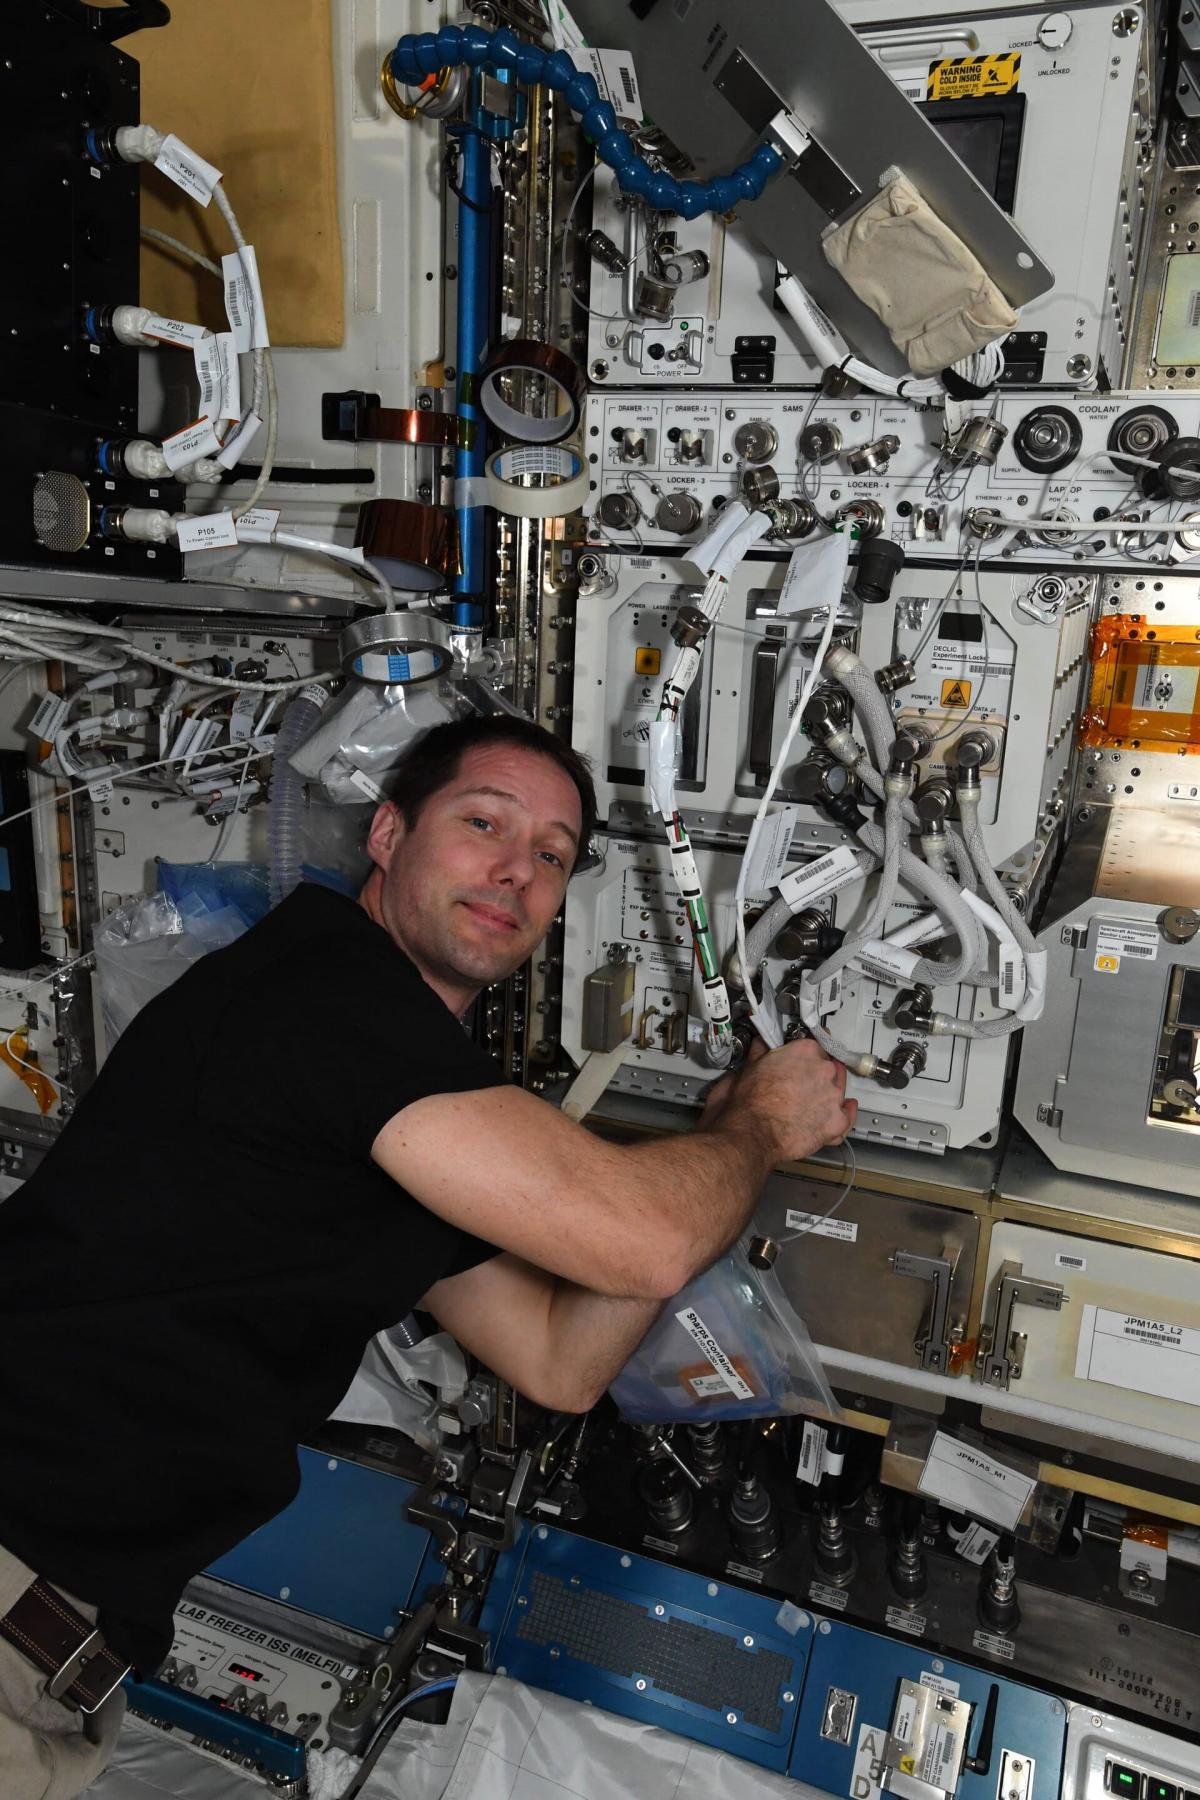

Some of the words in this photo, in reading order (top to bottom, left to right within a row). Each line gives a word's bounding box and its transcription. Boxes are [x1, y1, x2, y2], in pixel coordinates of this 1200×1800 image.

[940, 65, 982, 76] WARNING
[1038, 68, 1070, 76] UNLOCKED
[939, 76, 957, 85] COLD
[958, 74, 982, 82] INSIDE
[180, 162, 196, 179] P201
[167, 322, 184, 332] P202
[182, 440, 199, 451] P103
[198, 528, 216, 536] P105
[933, 652, 966, 660] Experiment
[1126, 929, 1156, 938] Atmosphere
[1124, 1317, 1183, 1336] JPM1A5_L2
[687, 1312, 709, 1339] Sharps
[706, 1340, 736, 1378] Container
[956, 1451, 1006, 1481] JPM1A5_M1
[178, 1604, 206, 1624] LAB
[206, 1614, 268, 1644] FREEZER
[267, 1637, 290, 1652] ISS
[290, 1647, 342, 1674] (MELFI)
[345, 1668, 352, 1678] 1
[860, 1733, 876, 1757] A
[868, 1758, 880, 1781] 5
[854, 1775, 871, 1799] D
